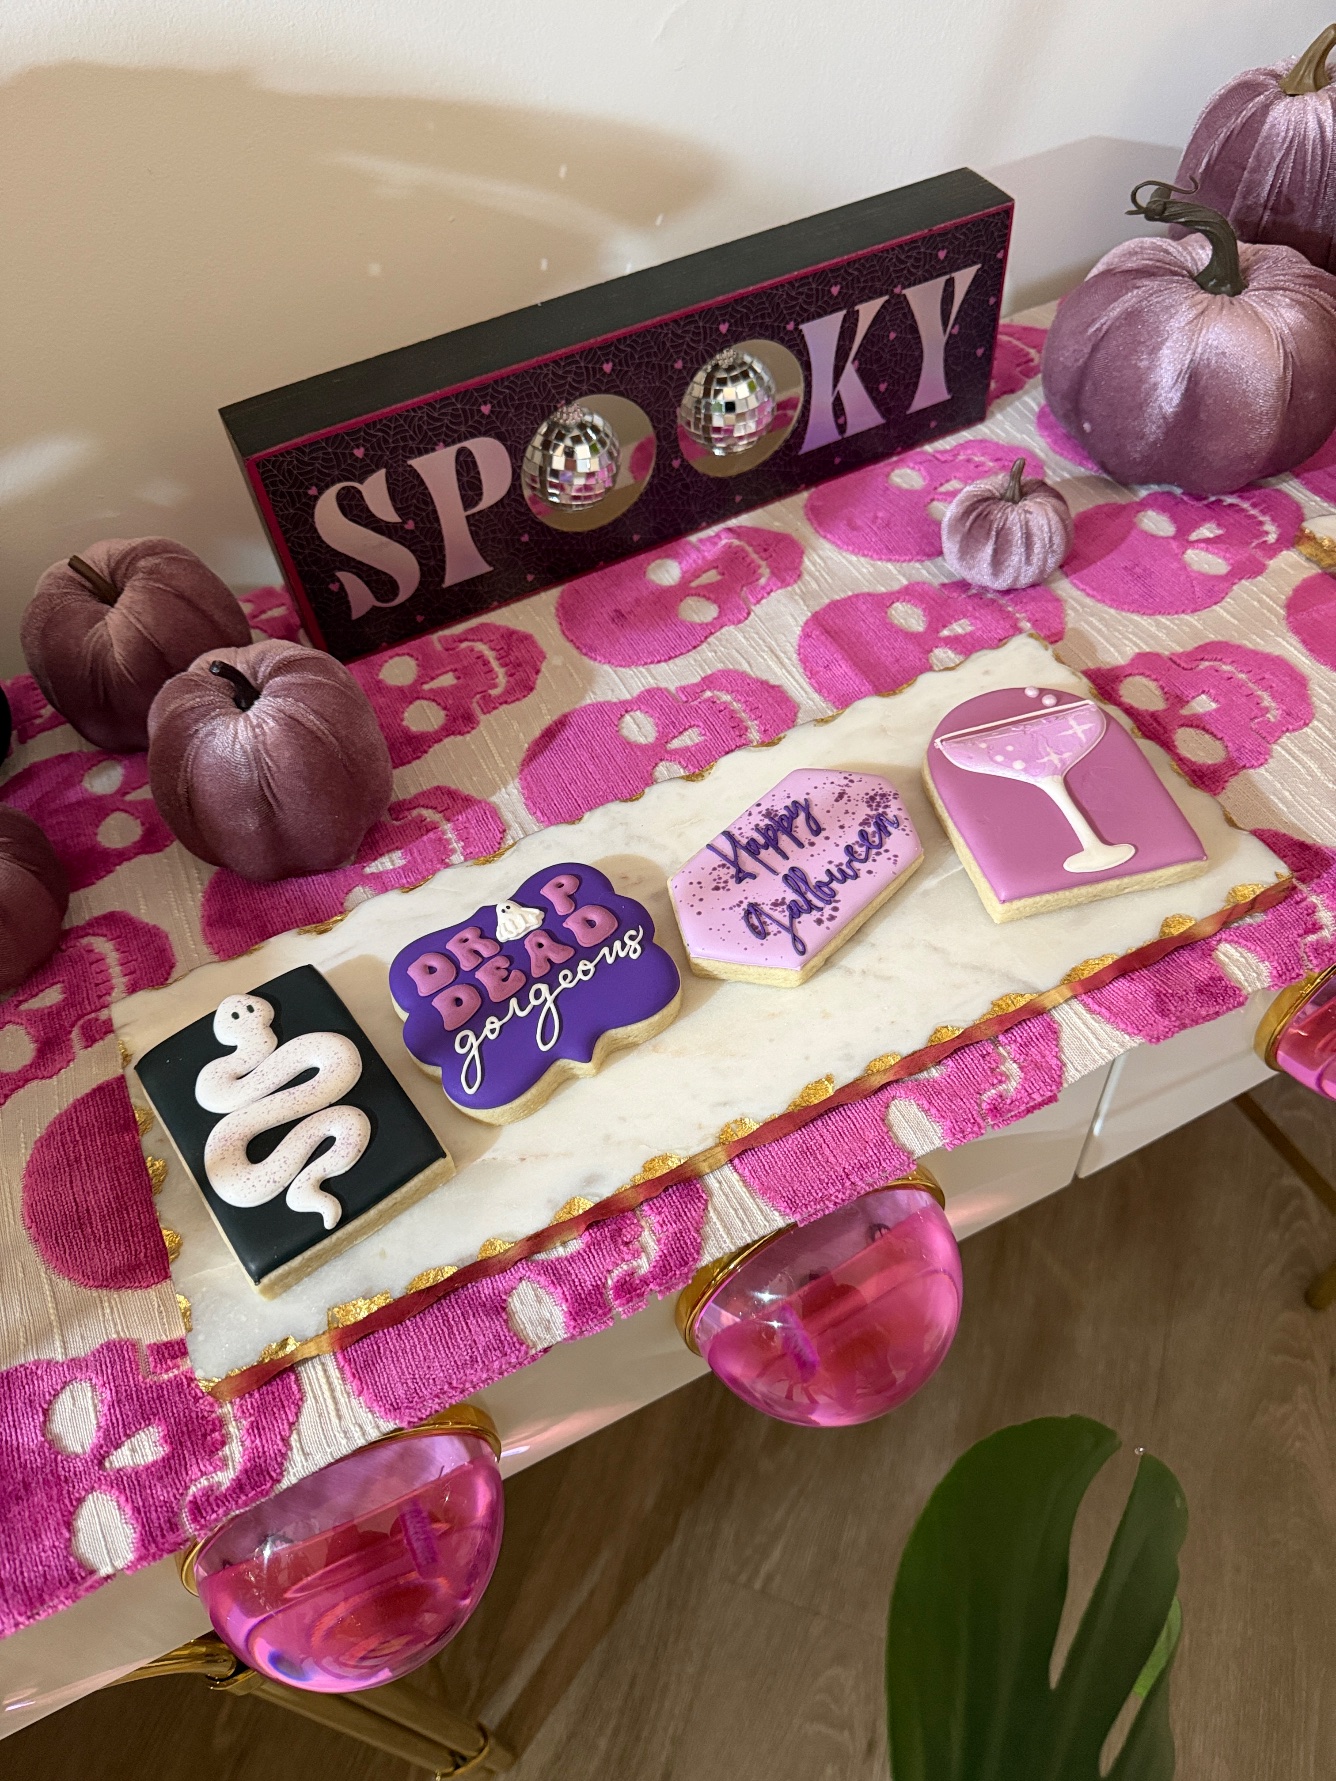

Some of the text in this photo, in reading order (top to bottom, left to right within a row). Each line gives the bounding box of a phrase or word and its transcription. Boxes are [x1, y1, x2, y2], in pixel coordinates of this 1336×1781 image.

[706, 798, 822, 884] Happy
[743, 812, 899, 956] Halloween
[406, 874, 580, 997] DRP
[431, 904, 618, 1031] DEAD
[454, 925, 643, 1095] gorgeous
